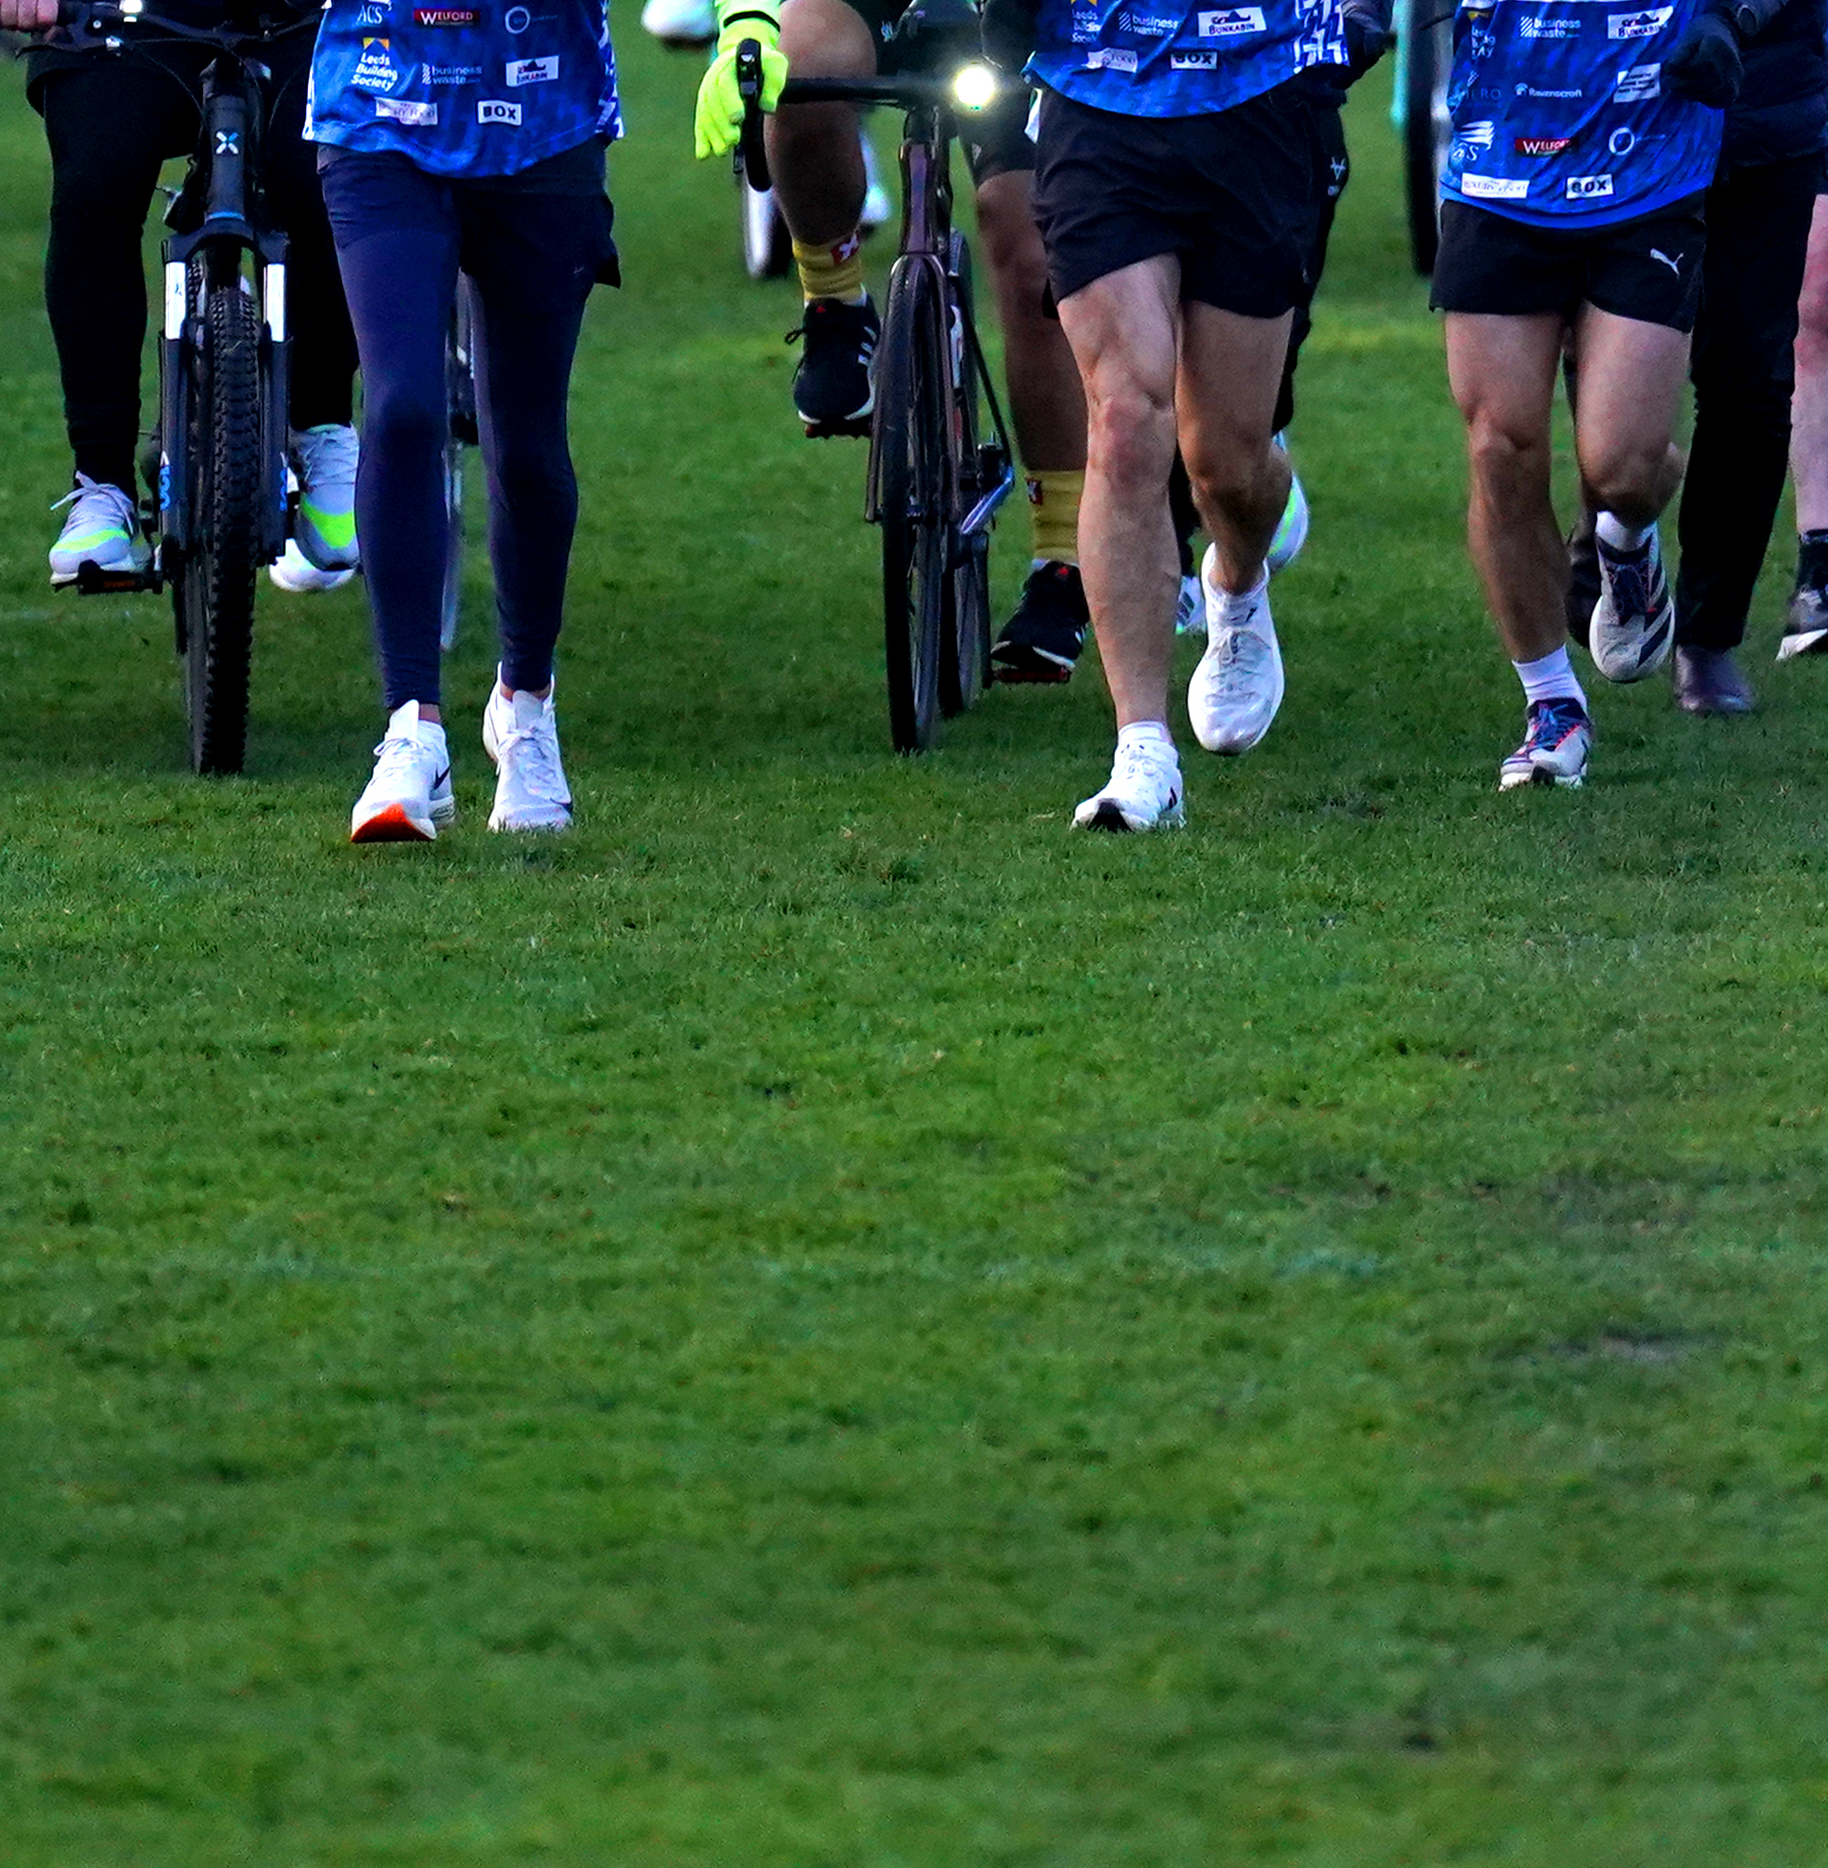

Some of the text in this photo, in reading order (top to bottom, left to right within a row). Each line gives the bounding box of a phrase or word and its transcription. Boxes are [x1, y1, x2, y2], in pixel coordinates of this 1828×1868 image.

[355, 4, 383, 25] ACS
[420, 11, 473, 25] WELFORD
[1132, 14, 1178, 30] business
[1209, 22, 1255, 35] BUNKABIN
[360, 52, 390, 66] Leeds
[355, 63, 398, 82] Building
[350, 74, 394, 92] Society
[483, 105, 516, 120] BOX
